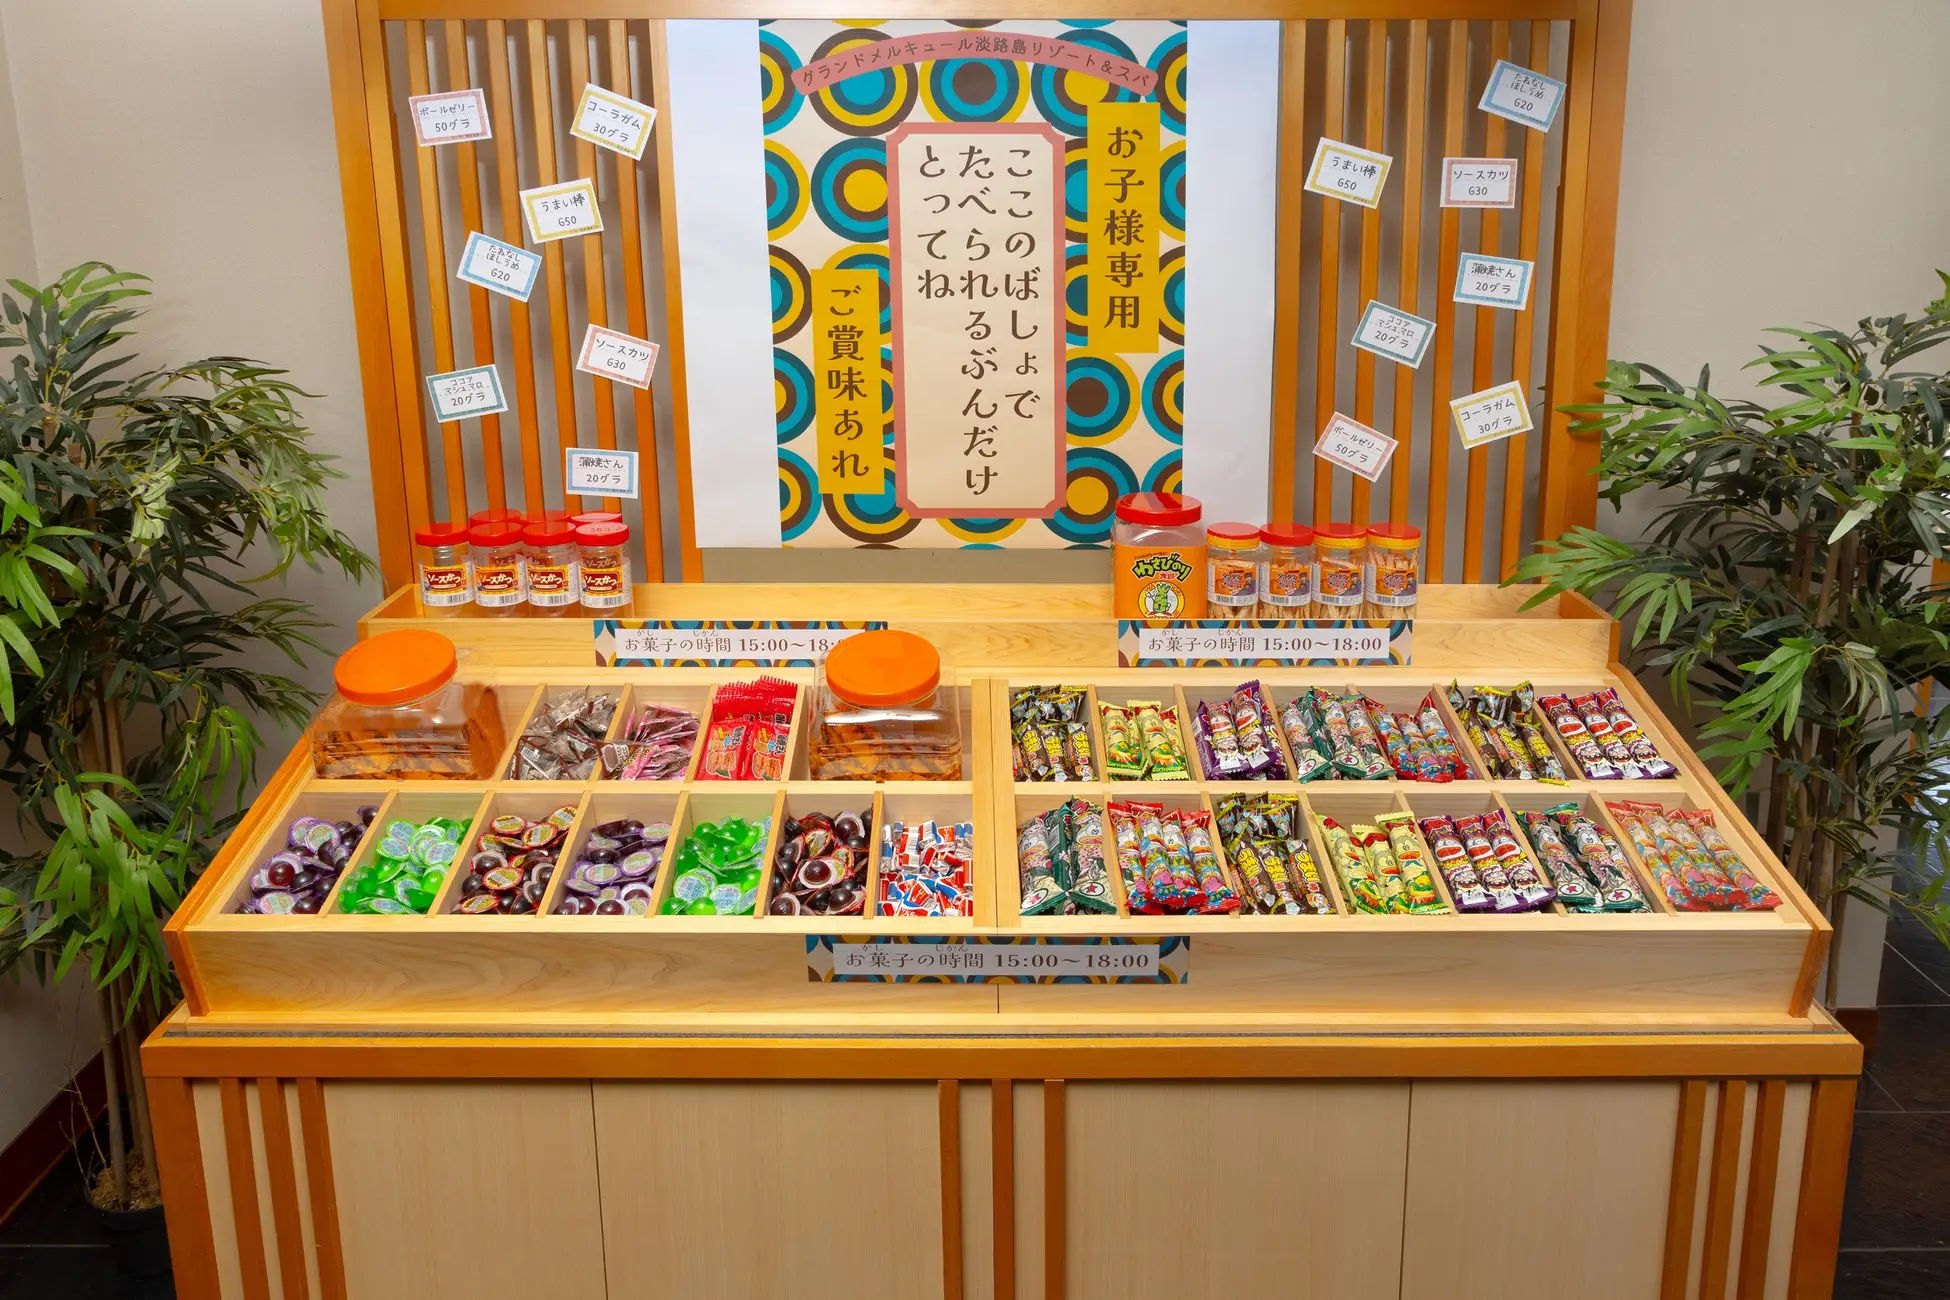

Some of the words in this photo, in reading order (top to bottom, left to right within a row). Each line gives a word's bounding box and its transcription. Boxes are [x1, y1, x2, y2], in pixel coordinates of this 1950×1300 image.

[802, 35, 1152, 87] グランドメルキュール淡路島リゾート&スパ
[419, 103, 476, 117] ボールゼリー
[587, 100, 641, 130] コーラガム
[434, 118, 470, 133] 50グラ
[592, 121, 630, 143] 30グラ
[1331, 156, 1377, 178] うまい棒
[1453, 169, 1509, 181] ソースカツ
[540, 193, 585, 213] うまい棒
[917, 144, 955, 300] とってね
[1103, 126, 1145, 330] お子様専用
[1004, 147, 1042, 420] ここのばしょで
[1475, 281, 1511, 295] 20グラ
[957, 145, 999, 495] たべられるぶんだけ
[595, 338, 650, 362] ソースカツ
[1374, 330, 1410, 349] 20グラ
[826, 285, 870, 478] ご賞味あれ
[450, 392, 485, 407] 20グラ
[1460, 398, 1516, 421] コーラガム
[1478, 415, 1513, 435] 30グラ
[1332, 425, 1383, 453] ボールゼリー
[1335, 443, 1370, 464] 50グラ
[586, 472, 621, 485] 20グラ
[1131, 551, 1193, 583] わさびのり
[624, 636, 732, 652] お菓子の時間
[1148, 636, 1256, 652] お菓子の時間
[1262, 636, 1382, 651] 15:00～18:00
[846, 952, 984, 969] お菓子の時間
[994, 953, 1149, 968] 15:00～18:00
